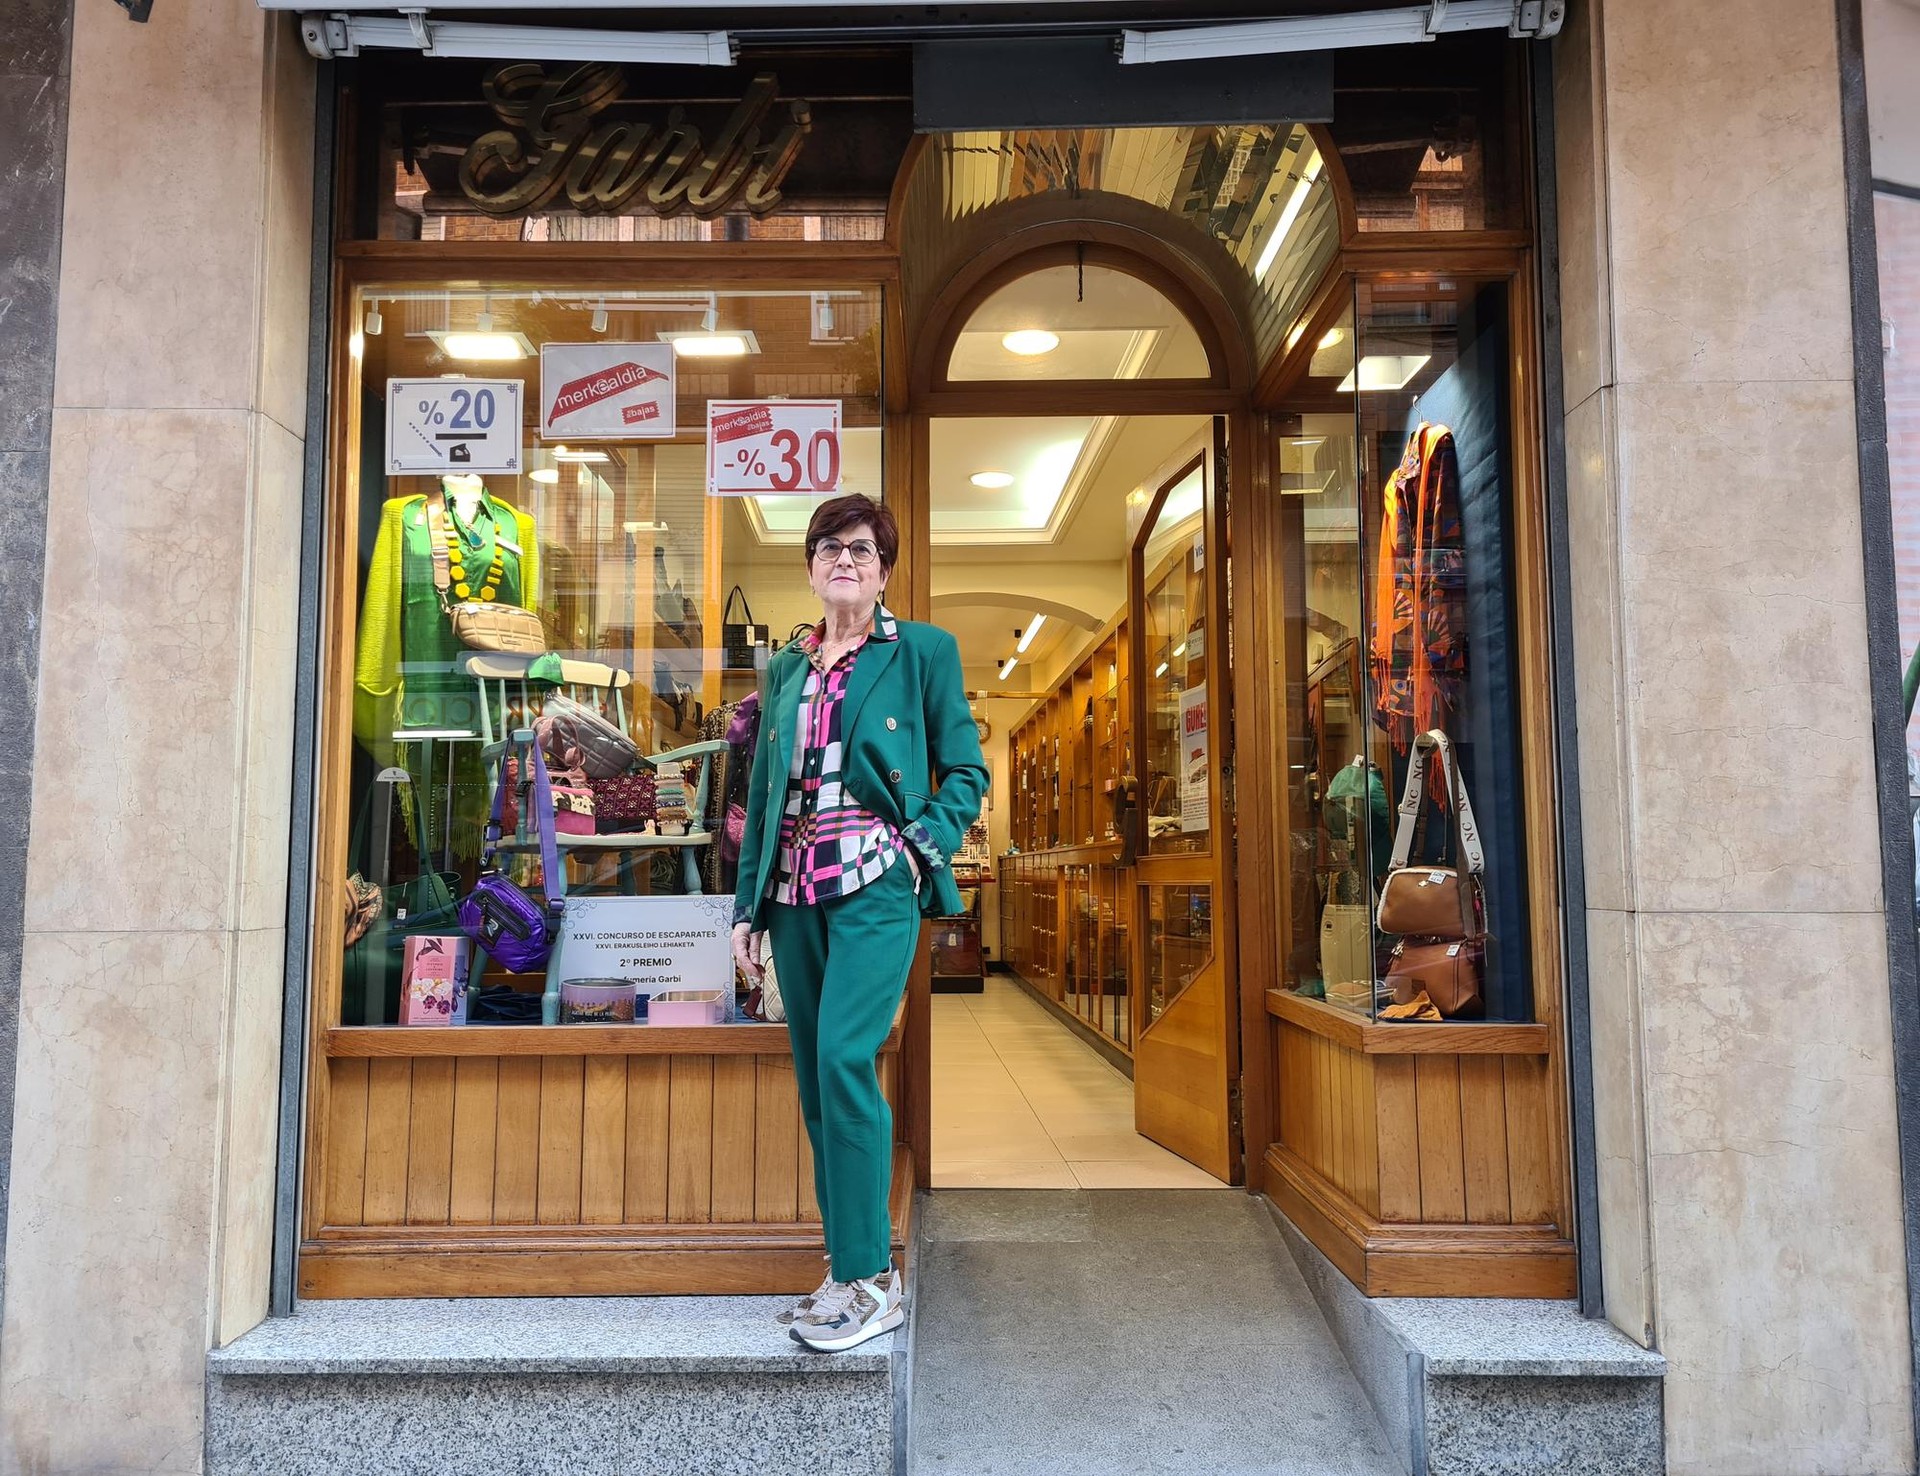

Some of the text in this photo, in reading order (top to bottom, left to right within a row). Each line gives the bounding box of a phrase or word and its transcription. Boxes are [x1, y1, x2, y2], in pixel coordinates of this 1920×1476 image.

[1195, 544, 1205, 559] VIS
[1407, 789, 1419, 809] NC
[1462, 822, 1477, 842] NC
[573, 930, 717, 941] XXVI. CONCURSO DE ESCAPARATES
[633, 957, 672, 967] PREMIO
[657, 974, 682, 983] Garbi
